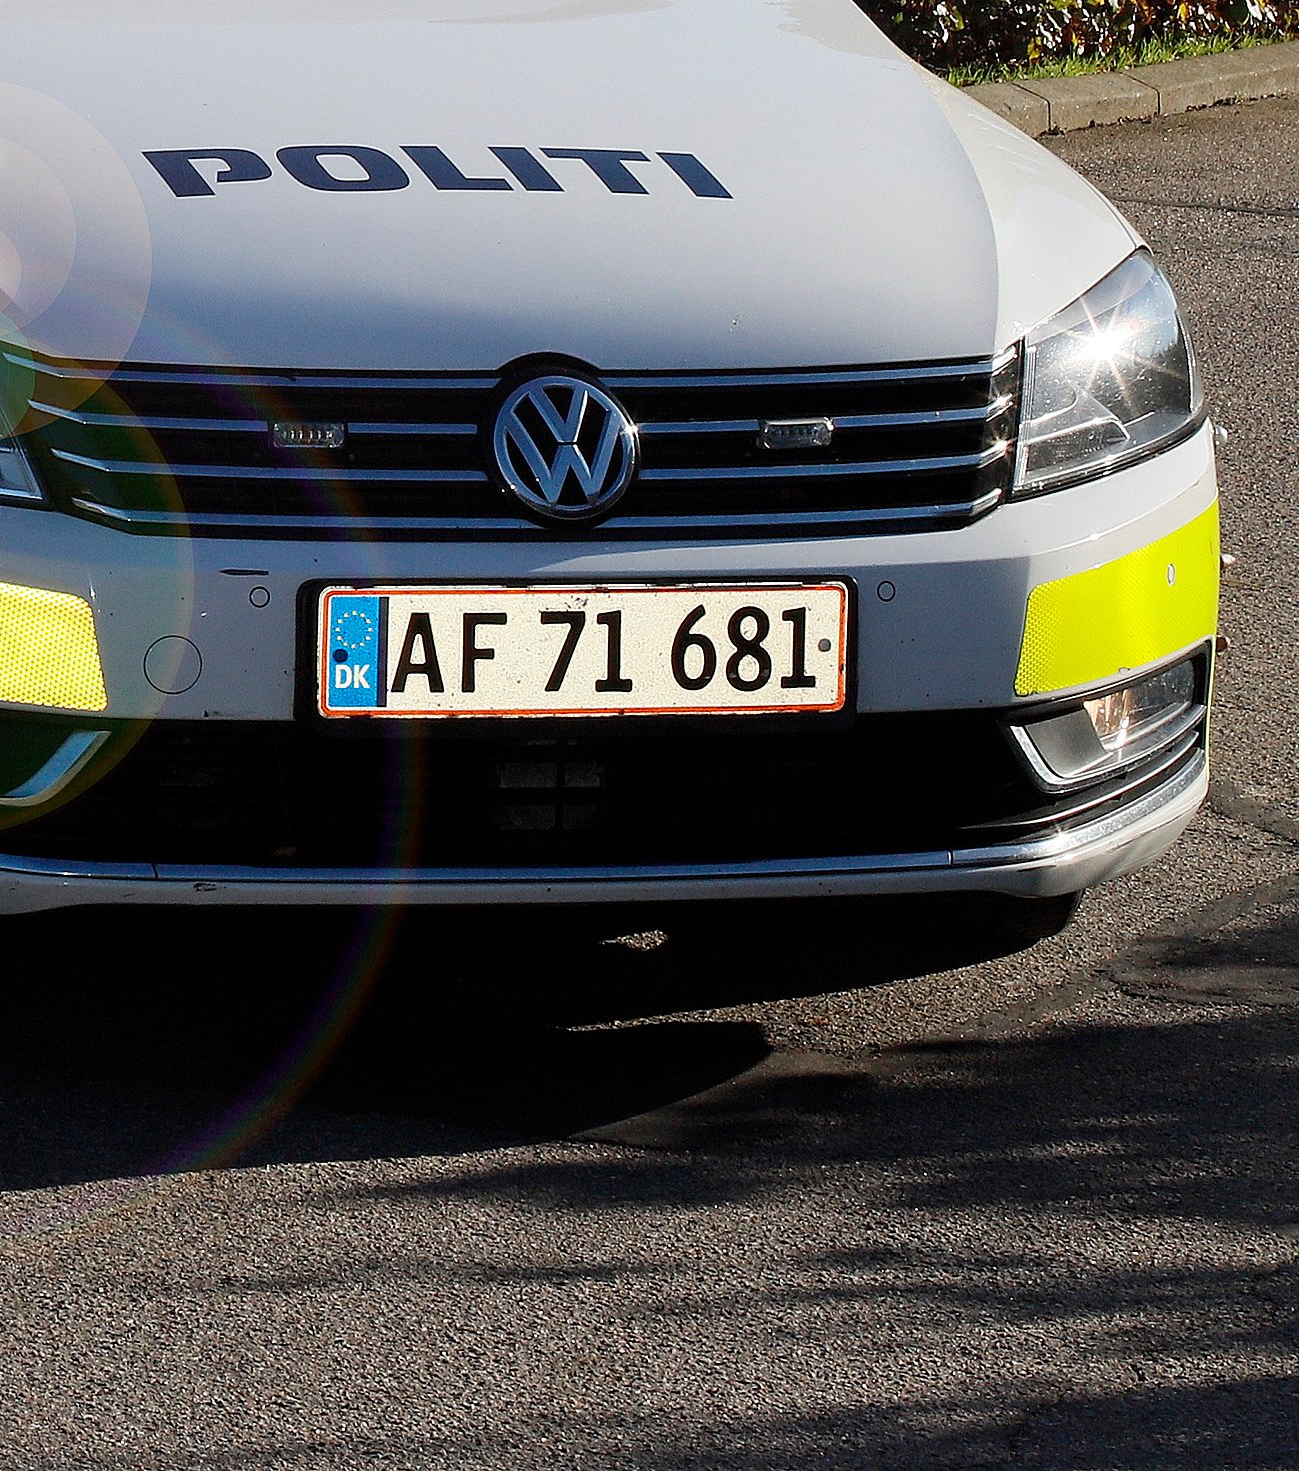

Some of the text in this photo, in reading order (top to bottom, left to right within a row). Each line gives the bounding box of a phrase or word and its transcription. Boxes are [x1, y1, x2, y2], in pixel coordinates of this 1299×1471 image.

[142, 144, 734, 199] POLITI
[391, 604, 817, 693] AF 71 681
[334, 664, 371, 689] DK
